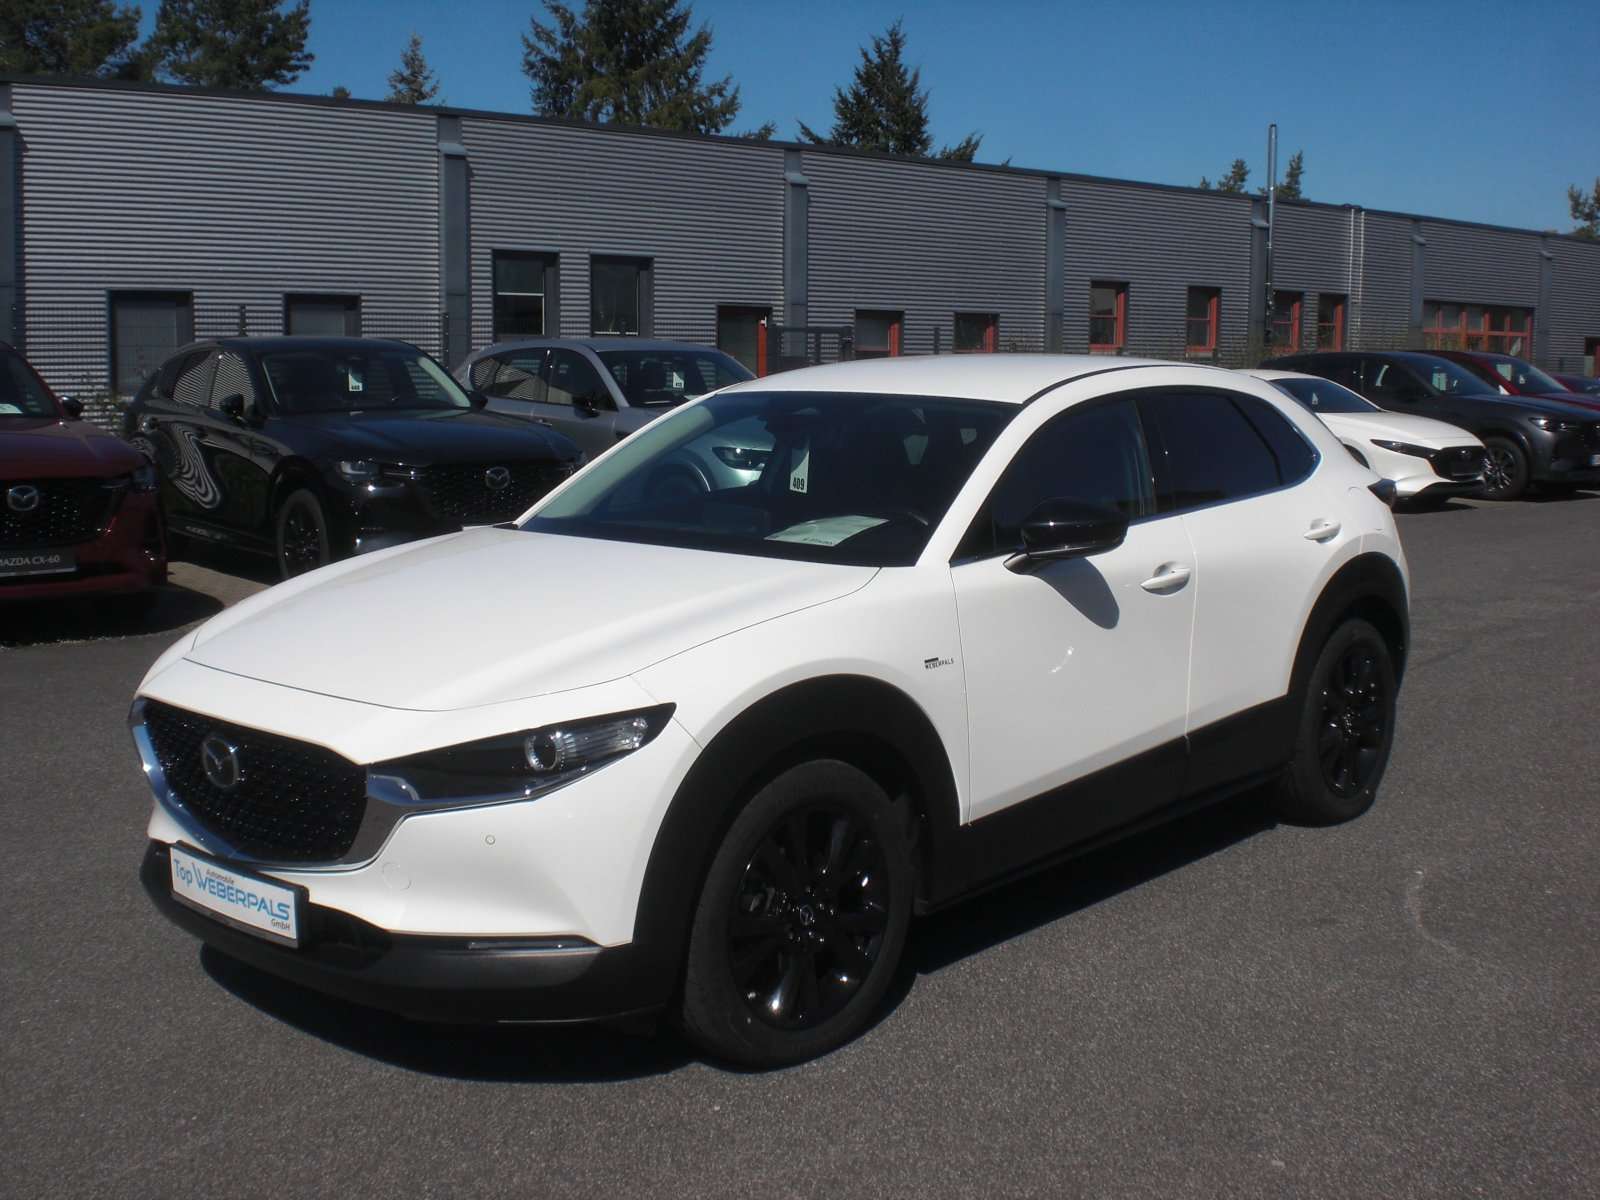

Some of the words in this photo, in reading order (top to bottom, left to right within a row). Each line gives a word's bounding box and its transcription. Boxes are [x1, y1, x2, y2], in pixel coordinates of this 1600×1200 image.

[793, 477, 805, 491] 409
[32, 554, 60, 565] CX-60
[173, 859, 193, 888] Top
[191, 862, 290, 921] WEBERPALS
[271, 918, 291, 931] GmbH
